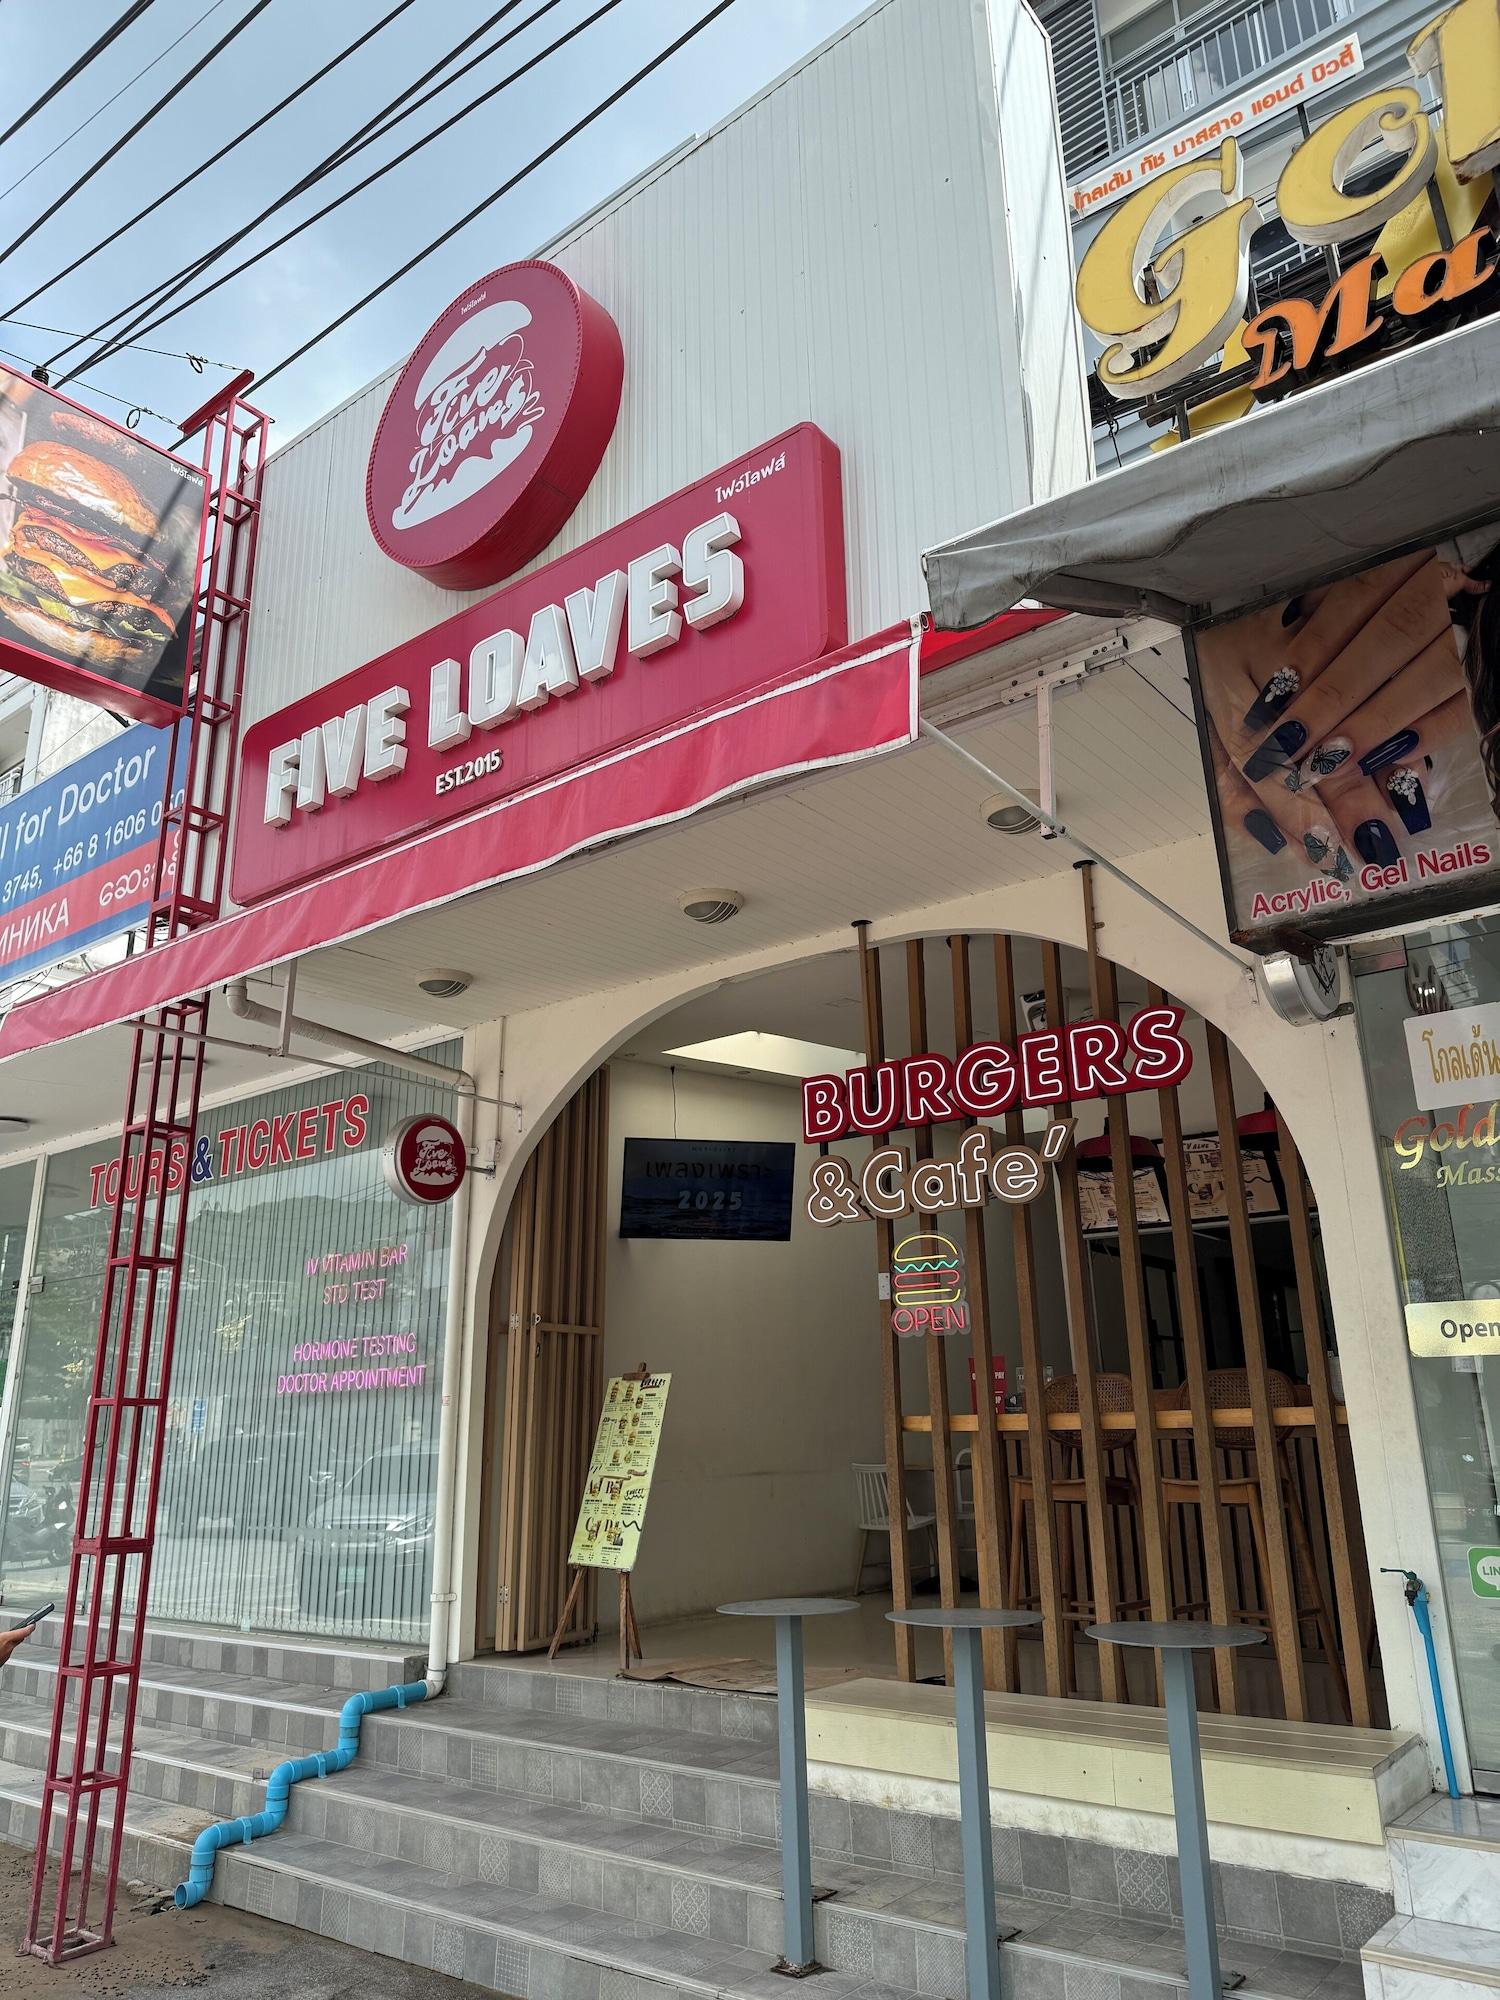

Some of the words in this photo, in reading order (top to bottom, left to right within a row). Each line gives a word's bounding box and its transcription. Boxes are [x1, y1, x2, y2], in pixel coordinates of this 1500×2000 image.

[264, 685, 410, 828] FIVE
[428, 512, 745, 753] LOAVES
[434, 748, 503, 795] EST.2015
[15, 805, 52, 852] for
[58, 744, 156, 827] Doctor
[2, 864, 43, 904] 3745,
[53, 840, 83, 876] +66
[87, 834, 99, 860] 8
[104, 808, 146, 850] 1606
[1251, 877, 1352, 920] Acrylic,
[1360, 860, 1407, 892] Gel
[1417, 842, 1491, 879] Nails
[803, 1005, 1192, 1144] BURGERS
[90, 1143, 185, 1208] TOURS
[191, 1135, 214, 1183] &
[218, 1093, 369, 1177] TICKETS
[677, 1190, 744, 1211] 2025
[322, 1249, 376, 1273] VITAMIN
[380, 1244, 408, 1268] BAR
[353, 1278, 387, 1302] TEST
[894, 1306, 965, 1332] OPEN
[1440, 1319, 1500, 1343] Open
[293, 1338, 359, 1362] HORMONE
[362, 1332, 417, 1357] TESTING
[277, 1372, 328, 1394] DOCTOR
[331, 1364, 427, 1392] APPOINTMENT
